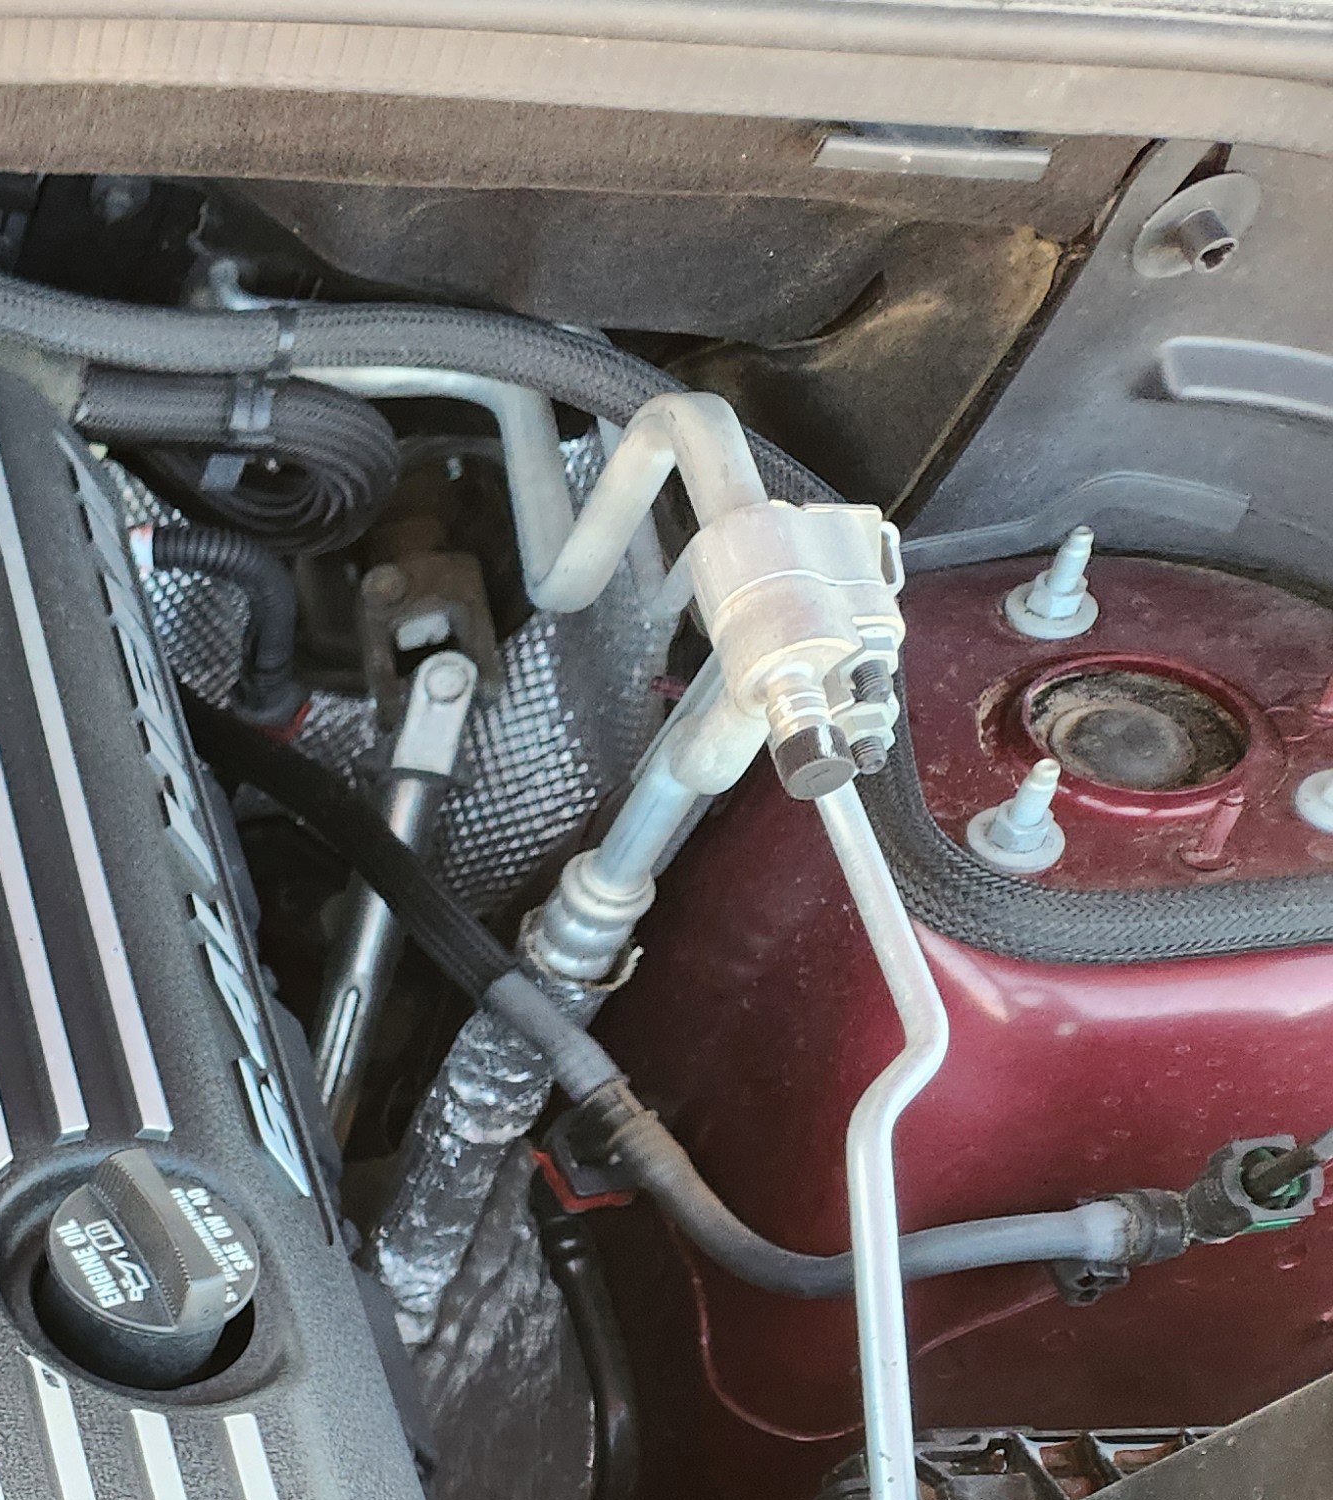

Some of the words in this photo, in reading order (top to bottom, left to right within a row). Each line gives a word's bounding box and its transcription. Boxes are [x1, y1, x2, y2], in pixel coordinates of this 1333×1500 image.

[55, 430, 218, 886] HEMI
[56, 1218, 87, 1248] OIL
[222, 1241, 255, 1272] SAE
[71, 1245, 126, 1309] ENGINE
